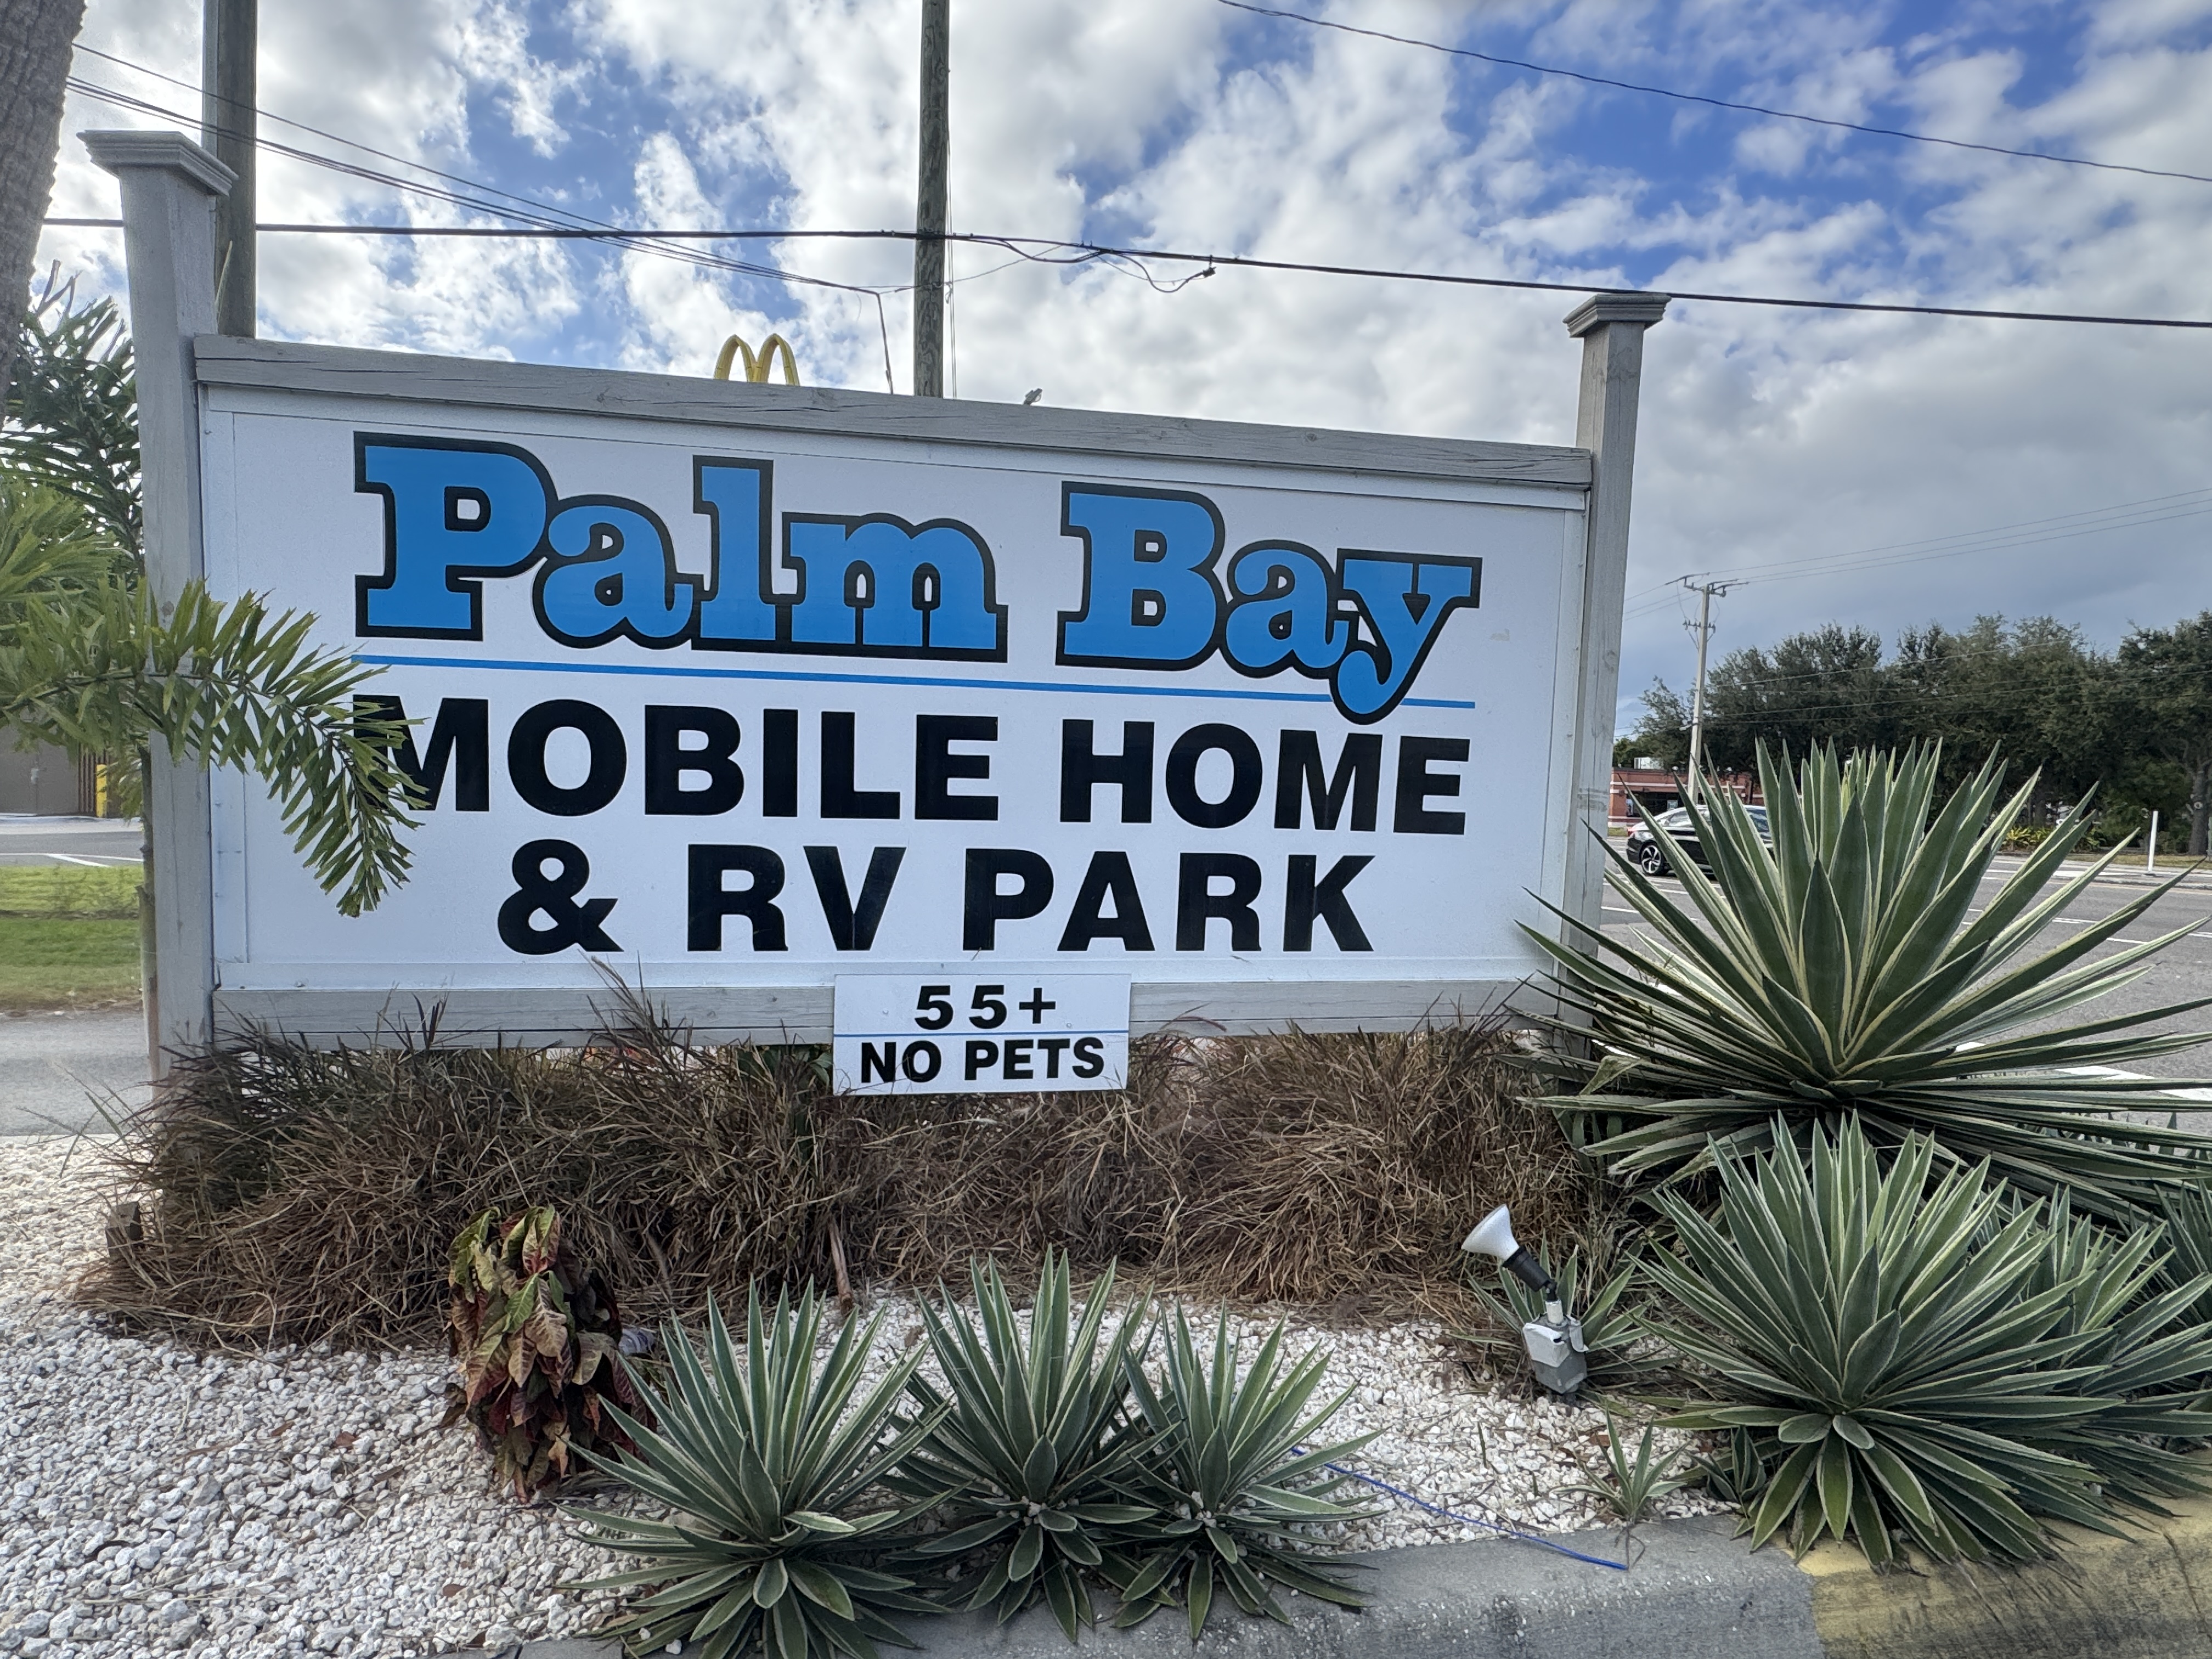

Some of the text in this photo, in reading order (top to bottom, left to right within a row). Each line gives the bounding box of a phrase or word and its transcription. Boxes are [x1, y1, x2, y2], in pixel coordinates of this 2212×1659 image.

[353, 431, 1483, 725] Palm Bay
[353, 695, 1470, 835] MOBILE HOME
[497, 838, 1375, 956] & RV PARK
[861, 1036, 1104, 1084] NO PETS
